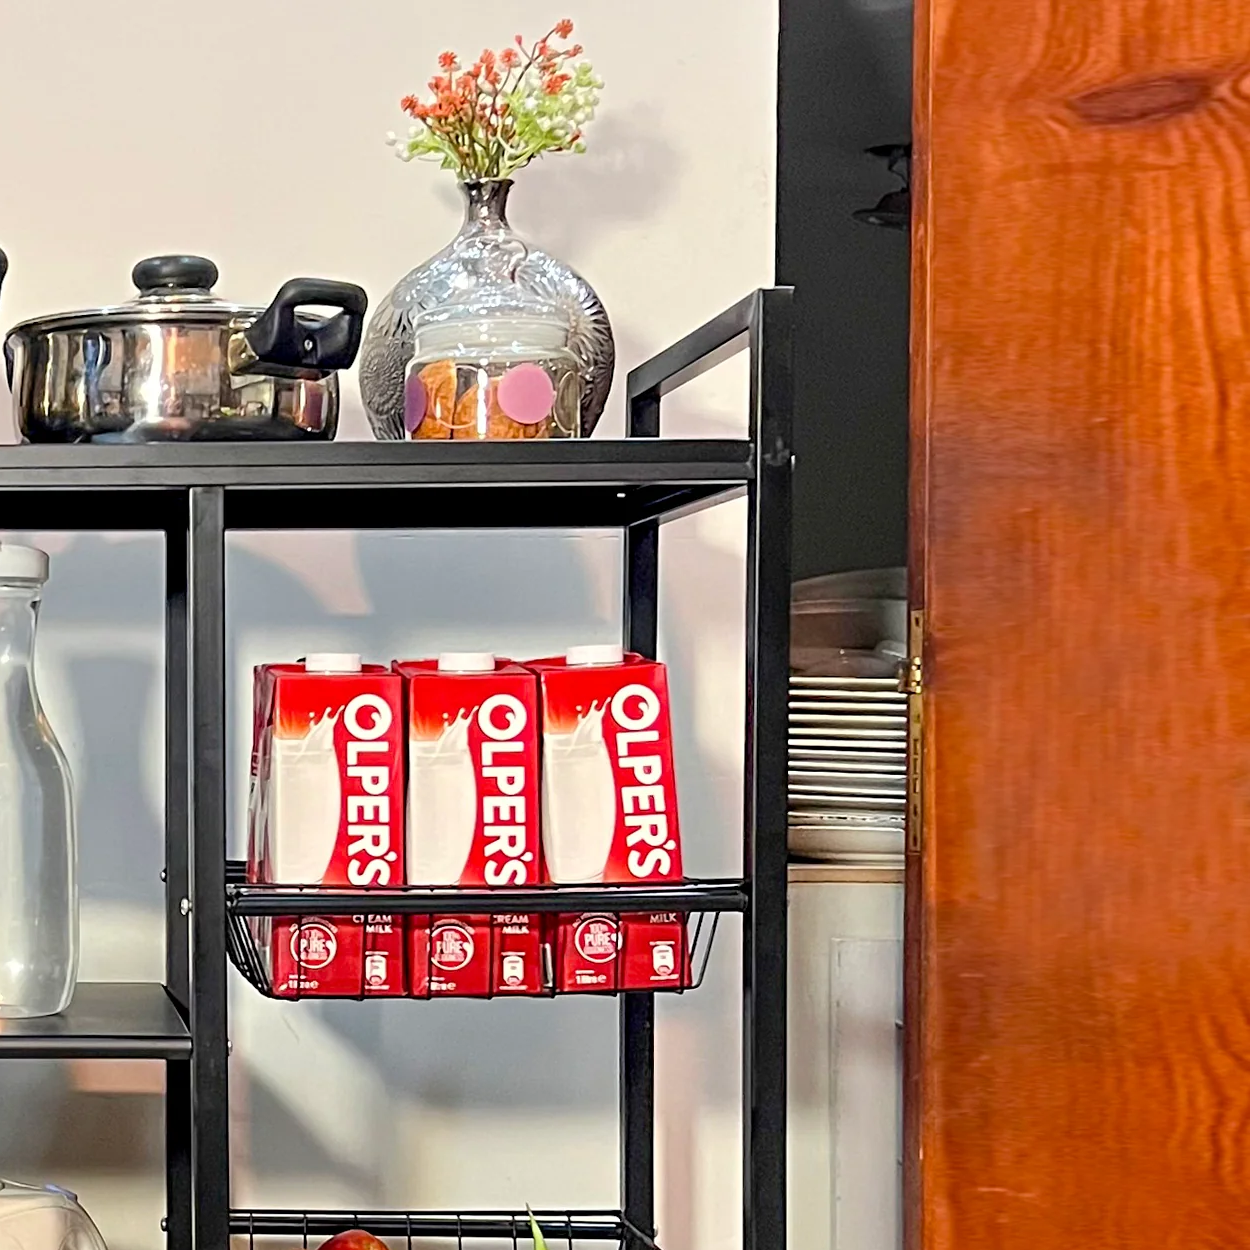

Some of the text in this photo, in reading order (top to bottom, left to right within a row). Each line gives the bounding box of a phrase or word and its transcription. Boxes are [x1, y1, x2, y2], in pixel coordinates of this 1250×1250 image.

[611, 683, 676, 878] OLPER'S
[344, 693, 398, 886] OLPER'S
[478, 693, 534, 886] OLPER'S
[353, 914, 392, 923] CEAM
[650, 913, 676, 923] MILK
[366, 925, 393, 933] MILK
[502, 926, 529, 934] MILK
[584, 932, 612, 946] PURE
